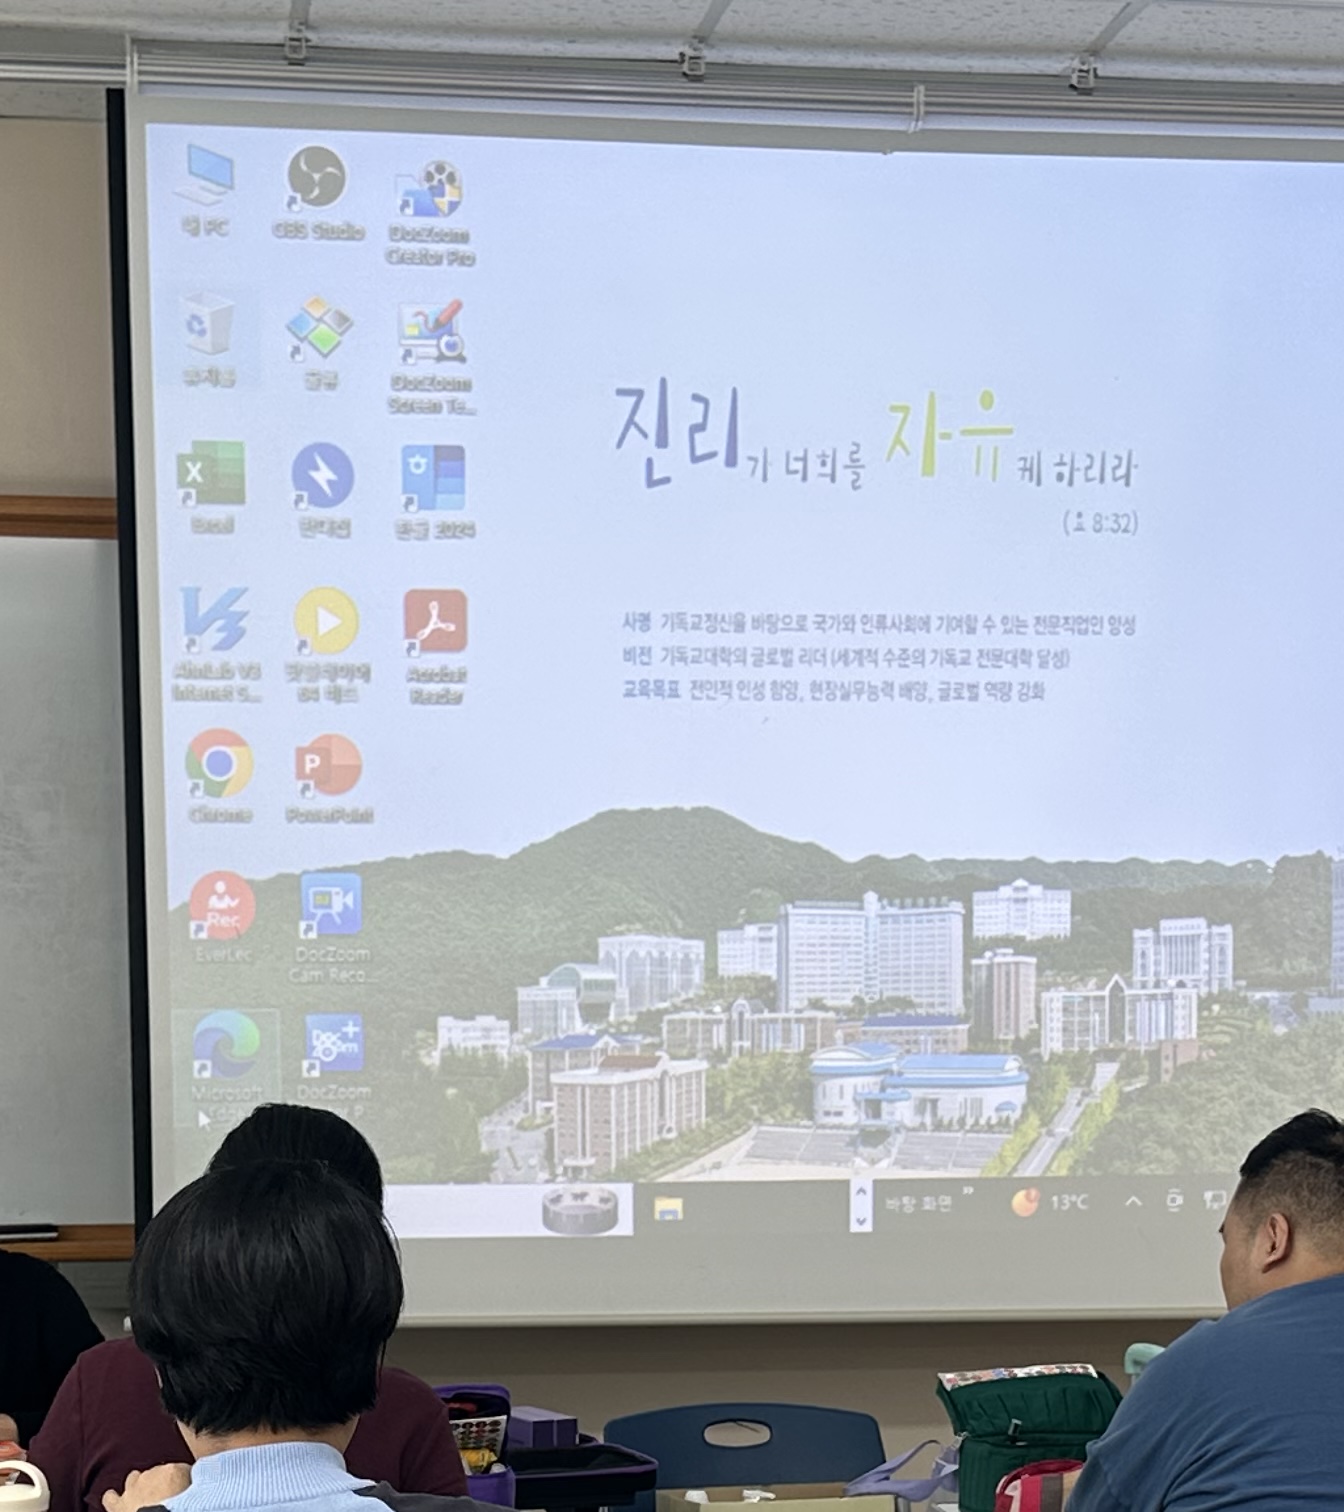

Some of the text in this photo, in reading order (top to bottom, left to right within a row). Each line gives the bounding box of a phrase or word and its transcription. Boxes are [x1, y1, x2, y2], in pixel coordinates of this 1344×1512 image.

[784, 441, 866, 491] 너희를
[1054, 448, 1140, 488] 하리라
[1092, 508, 1140, 536] 8:32)
[622, 611, 652, 633] 사명
[661, 611, 746, 634] 기독교정신을
[751, 612, 808, 635] 바탕으로
[812, 613, 856, 635] 국가와
[861, 613, 931, 635] 인류사회에
[936, 614, 978, 635] 기여할
[982, 614, 996, 635] 수
[1001, 614, 1029, 636] 있는
[1033, 614, 1103, 636] 전문직업인
[622, 646, 652, 666] 비전
[660, 646, 747, 667] 기독교대학의
[750, 647, 794, 667] 글로벌
[798, 647, 826, 668] 리더
[830, 647, 878, 668] (세계적
[882, 648, 926, 668] 수준의
[930, 648, 972, 668] 기독교
[976, 649, 1032, 669] 전문대학
[622, 679, 681, 699] 교육목표
[690, 680, 733, 701] 전인적
[736, 680, 765, 701] 인성
[809, 680, 894, 702] 현장실무능력
[937, 681, 979, 702] 글로벌
[1017, 682, 1045, 702] 강화
[295, 946, 371, 963] DocZoom
[191, 1085, 264, 1100] Microsoft
